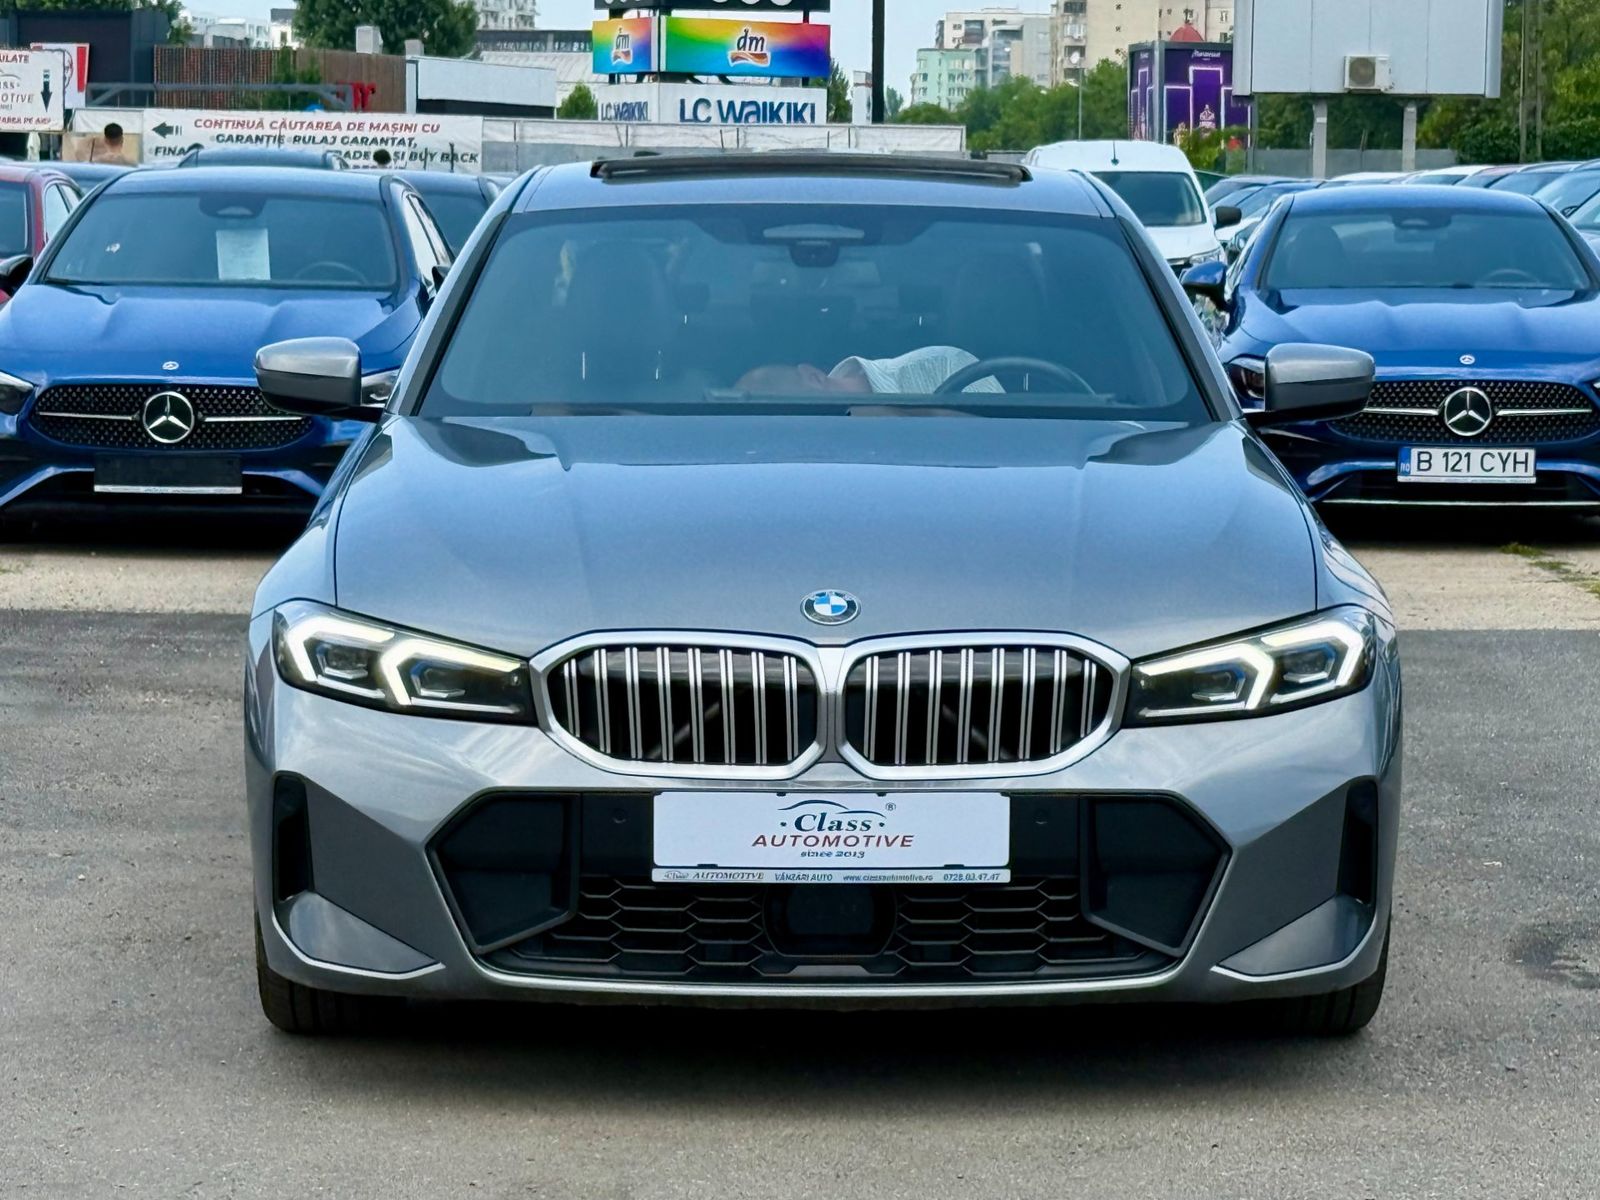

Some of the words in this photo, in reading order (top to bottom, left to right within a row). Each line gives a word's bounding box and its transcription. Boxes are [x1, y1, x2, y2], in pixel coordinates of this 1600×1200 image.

[737, 30, 765, 52] dm
[0, 53, 30, 64] ULATE
[0, 92, 35, 104] OTIVE
[679, 98, 712, 123] LC
[194, 117, 265, 130] CONTINUĂ
[269, 118, 342, 131] CĂUTAREA
[346, 121, 365, 131] DE
[422, 123, 441, 133] CU
[292, 134, 337, 145] RULAJ
[154, 146, 188, 156] FINA
[408, 151, 438, 162] BUY
[1416, 451, 1433, 472] B
[1442, 452, 1472, 473] 121
[1480, 452, 1529, 473] CYH
[794, 812, 872, 832] Class
[752, 834, 914, 848] AUTOMOTIVE
[800, 850, 833, 858] since
[692, 872, 765, 880] AUTOMOTIVE
[810, 873, 833, 881] AUTO
